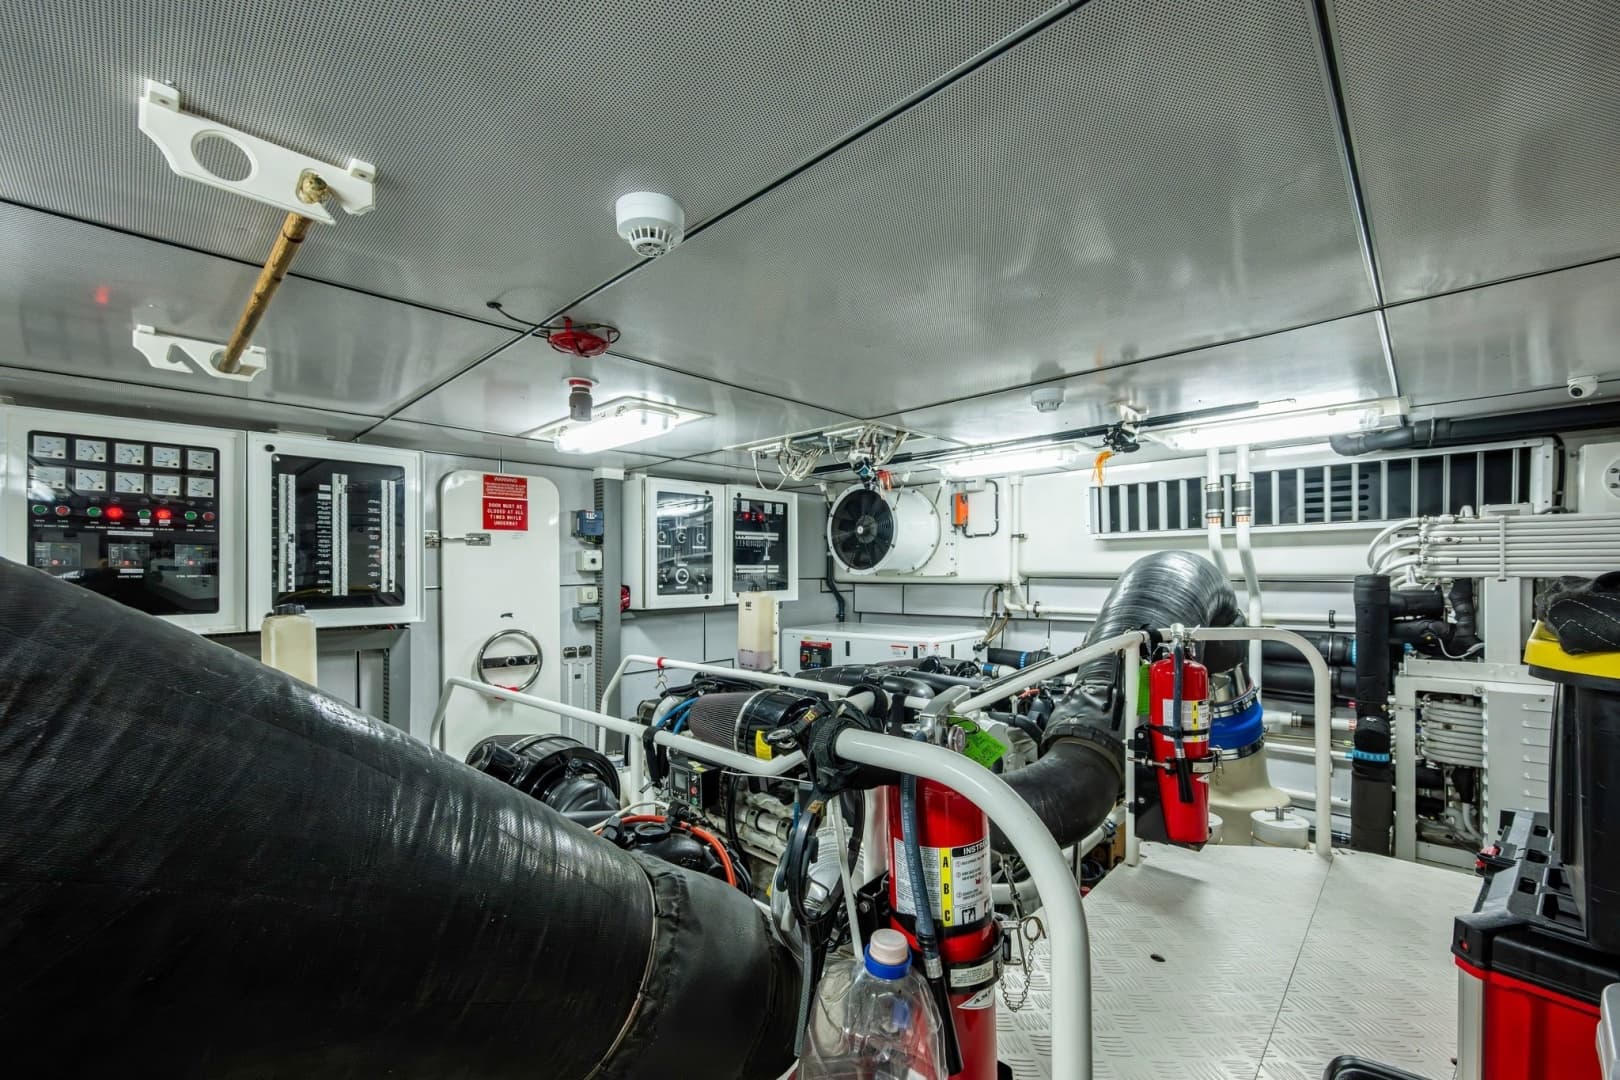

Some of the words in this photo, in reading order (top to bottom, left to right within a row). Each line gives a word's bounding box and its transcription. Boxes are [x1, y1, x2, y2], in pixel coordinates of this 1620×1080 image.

[943, 856, 949, 868] A
[943, 883, 950, 895] B
[944, 910, 951, 921] C
